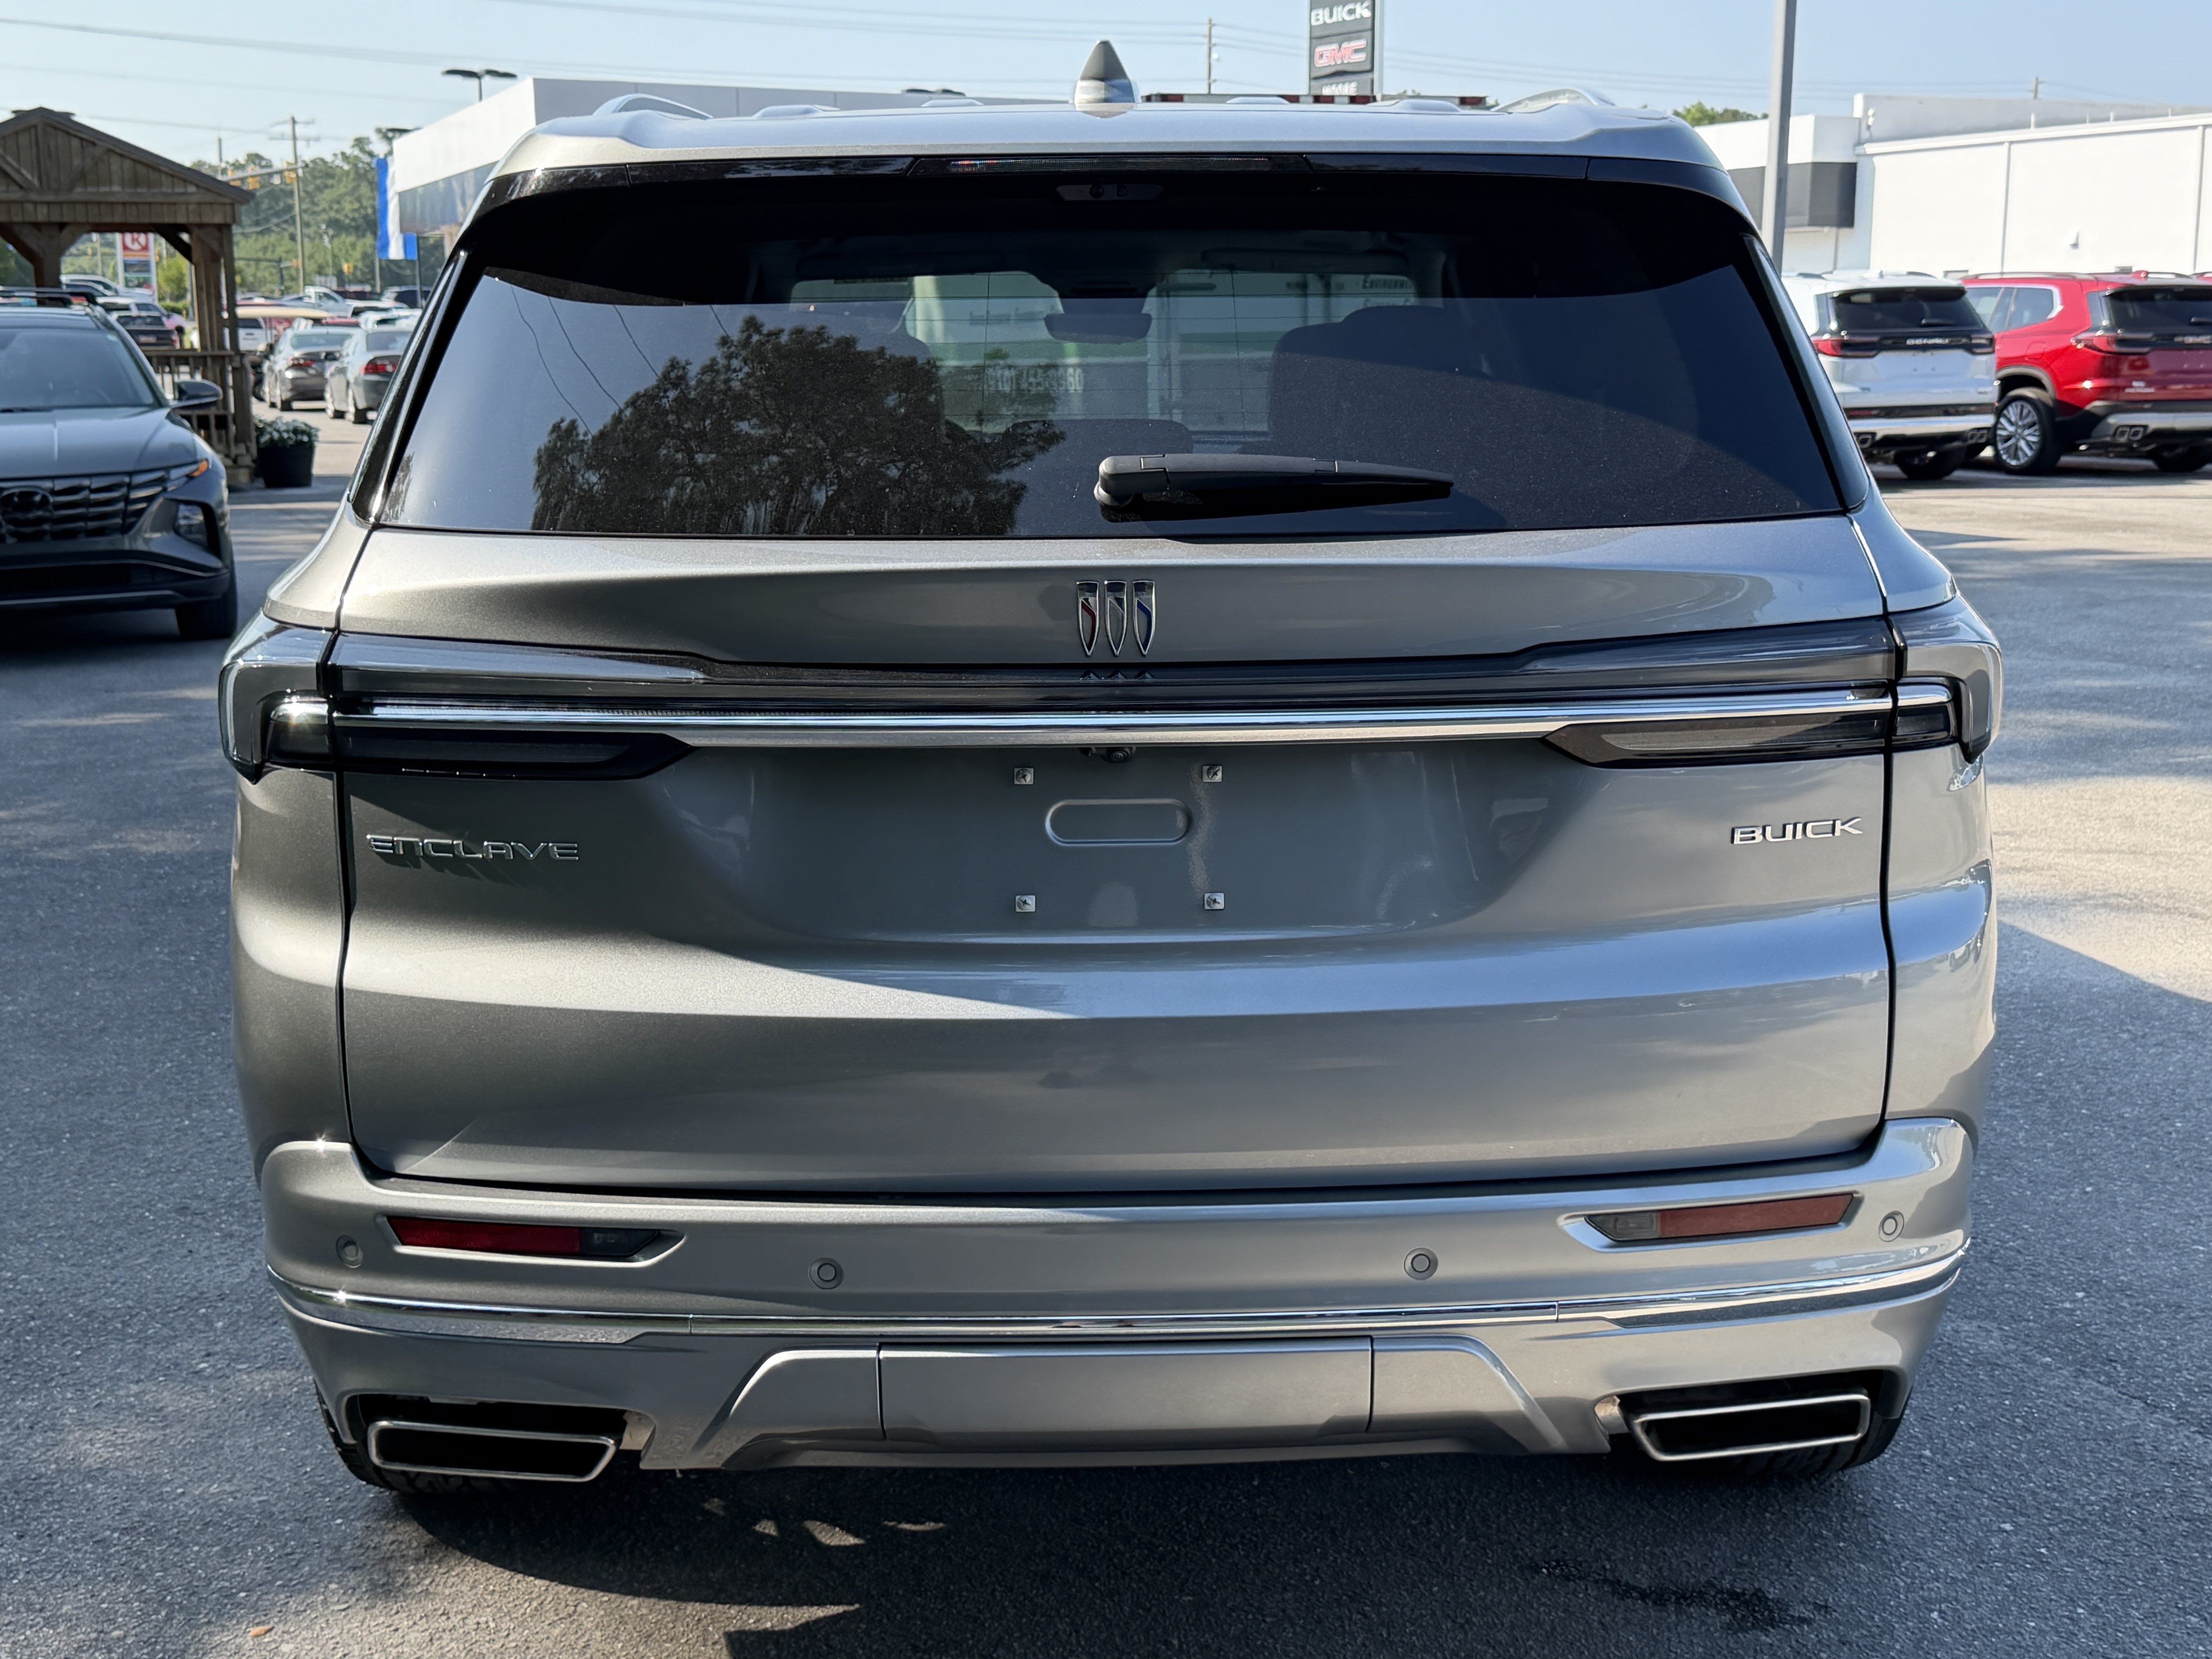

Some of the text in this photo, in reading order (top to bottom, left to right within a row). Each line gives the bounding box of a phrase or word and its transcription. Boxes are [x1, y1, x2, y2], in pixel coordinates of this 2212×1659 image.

[1311, 1, 1371, 26] BUICK
[1314, 39, 1367, 67] GMC
[1731, 817, 1863, 844] BUICK
[366, 834, 579, 860] ENCLAVE
